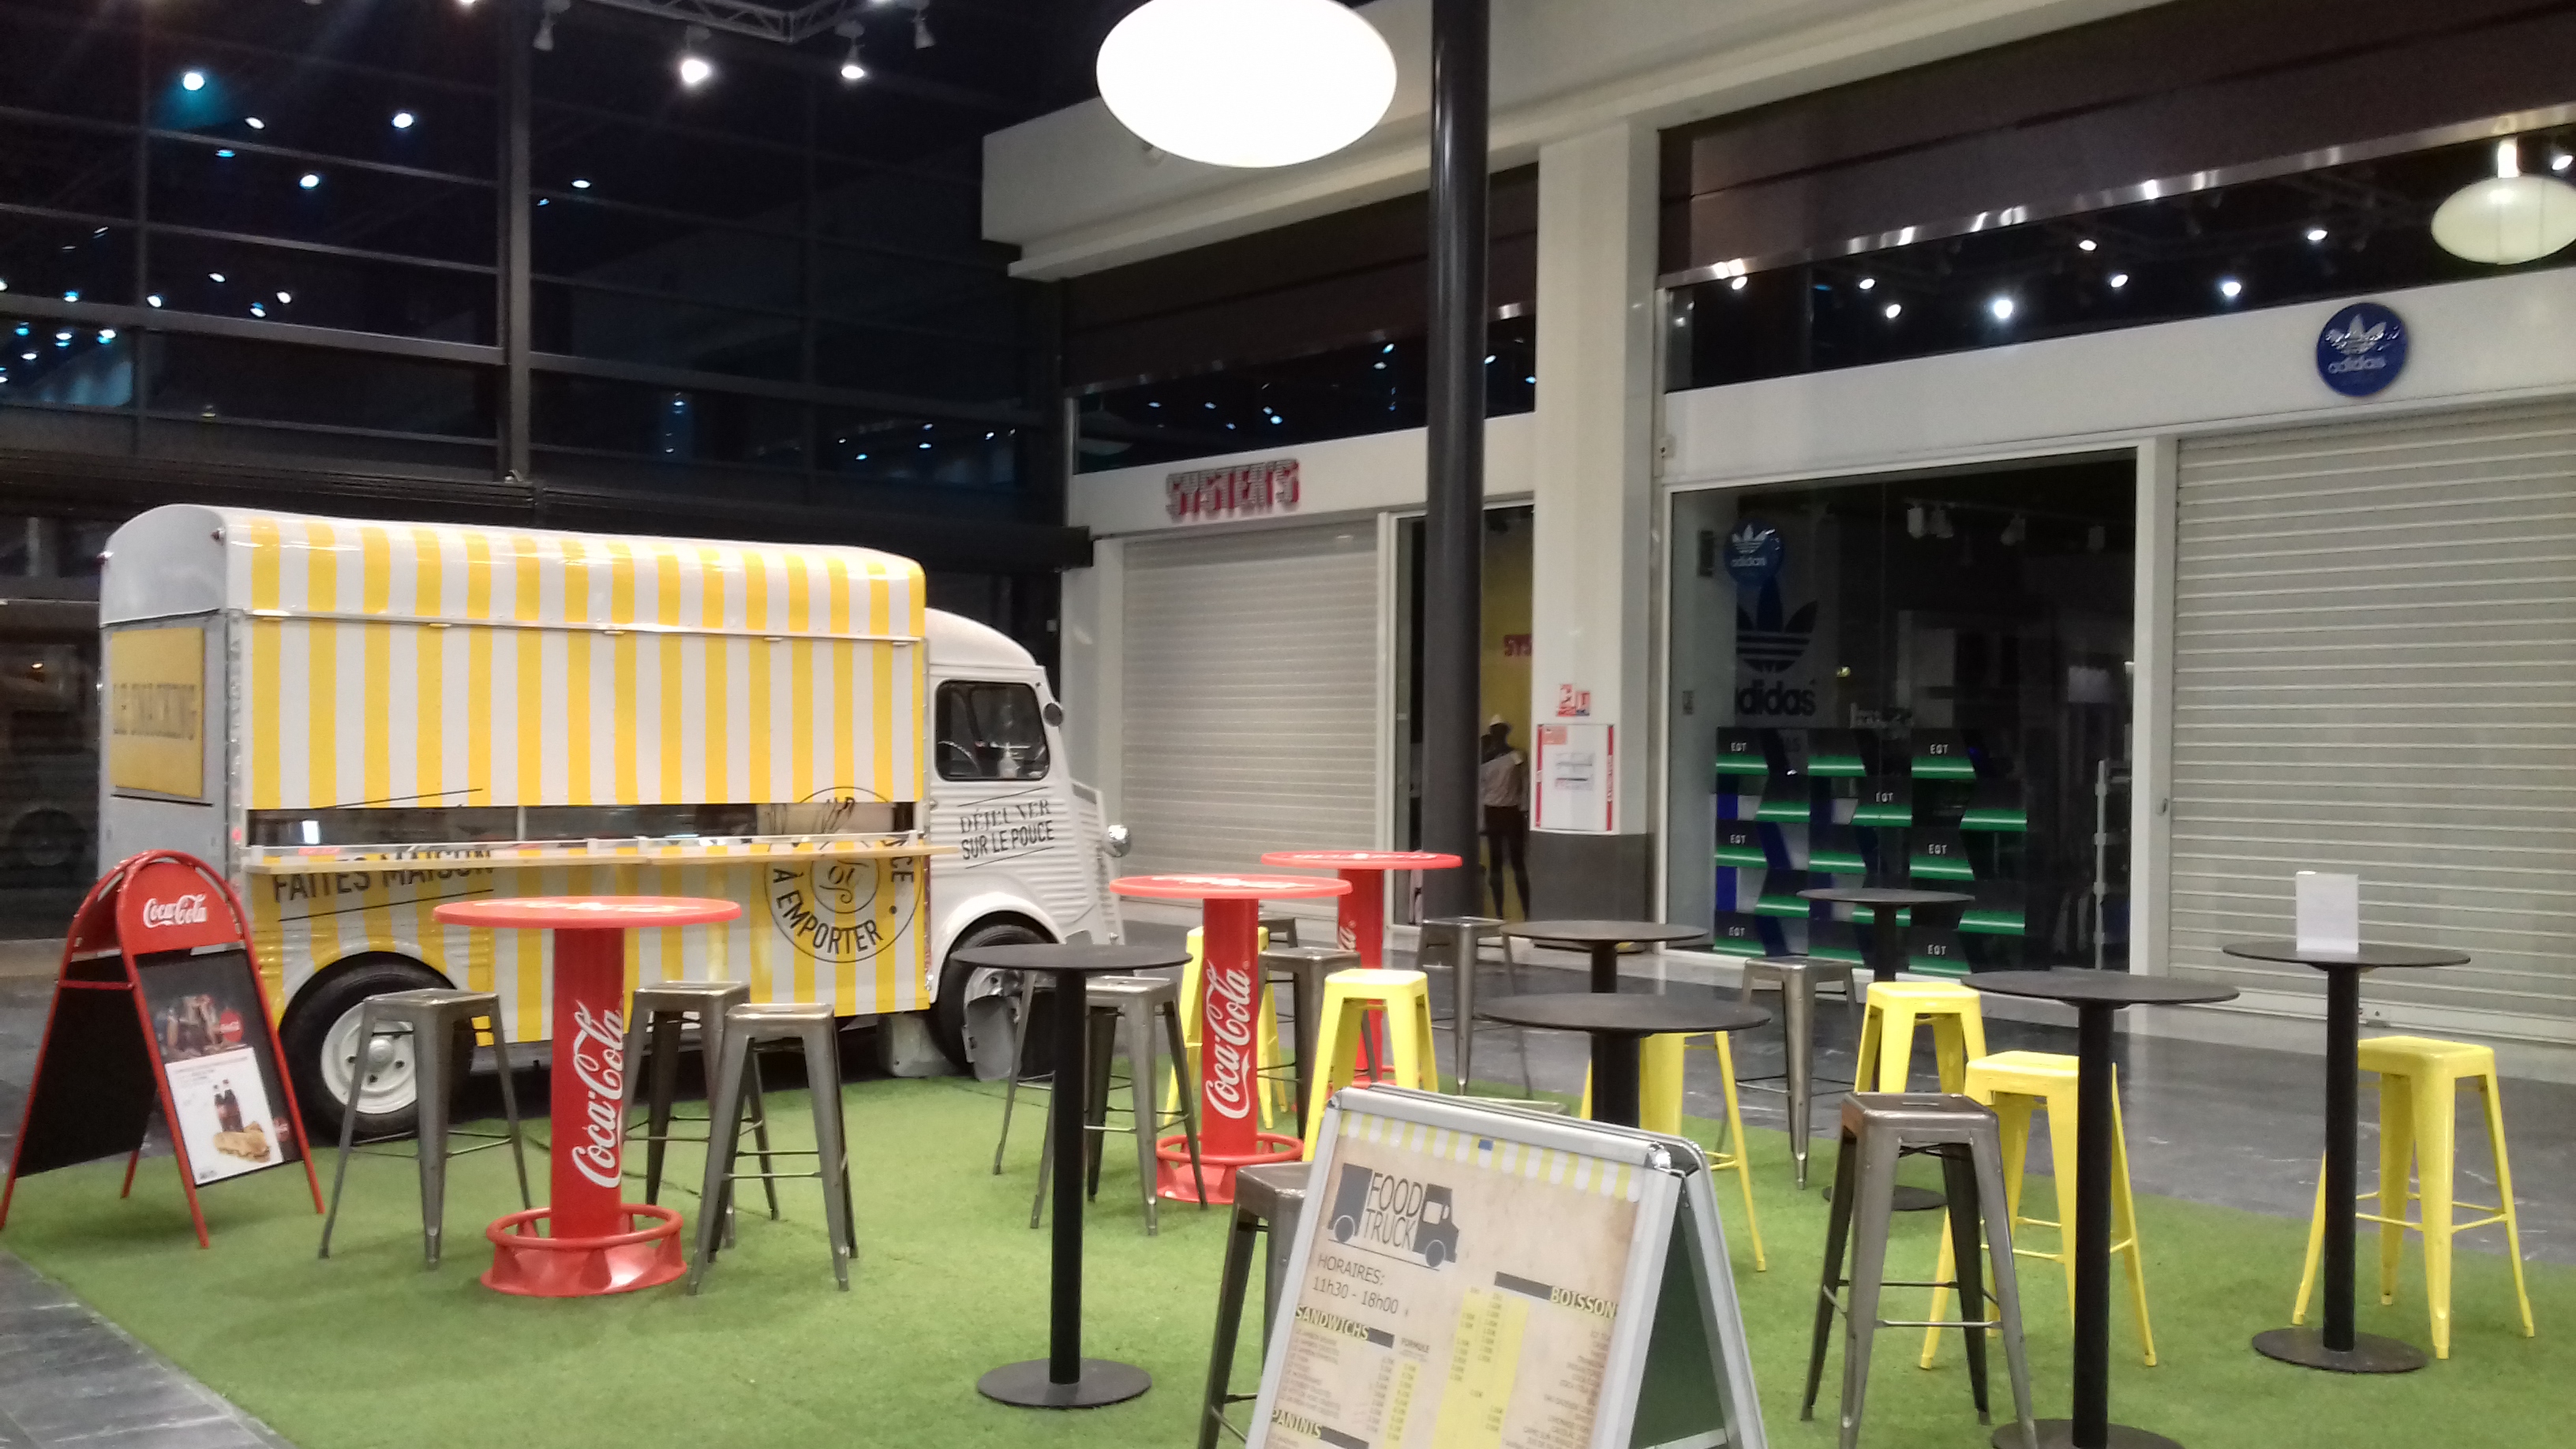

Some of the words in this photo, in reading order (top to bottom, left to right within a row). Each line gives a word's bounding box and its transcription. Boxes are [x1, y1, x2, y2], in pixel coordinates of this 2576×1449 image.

[2328, 354, 2387, 374] adidas
[1736, 679, 1816, 716] didas
[961, 835, 988, 860] SUR
[992, 830, 1009, 853] LE
[1011, 820, 1055, 849] POUCE
[776, 890, 884, 954] EMPORTER
[1367, 1172, 1423, 1218] FOOD
[1363, 1208, 1417, 1251] TRUCK
[1317, 1253, 1386, 1286] HORAIRES:
[1312, 1276, 1350, 1300] 11h30
[1361, 1290, 1398, 1315] 18h00
[1295, 1305, 1370, 1341] SANDWICHS
[1271, 1406, 1323, 1439] PANINIS
